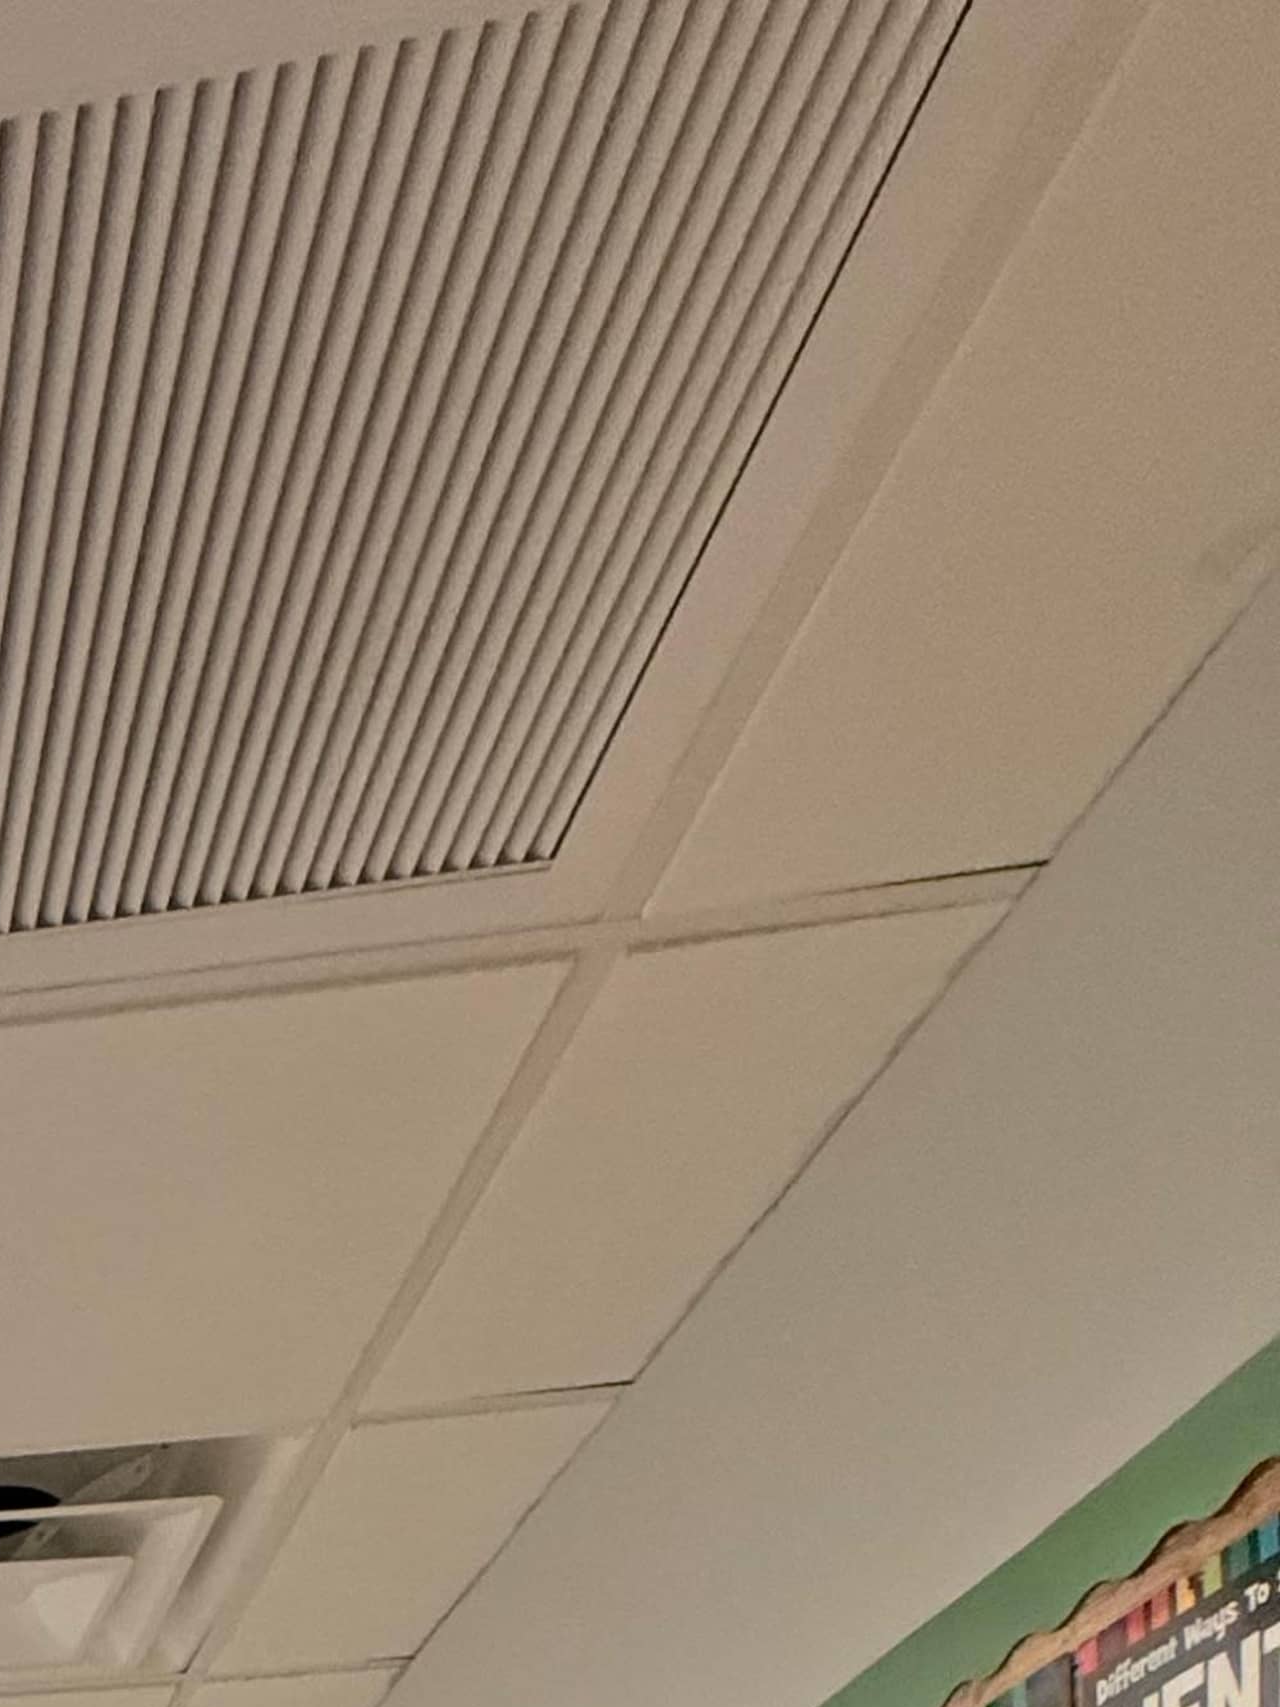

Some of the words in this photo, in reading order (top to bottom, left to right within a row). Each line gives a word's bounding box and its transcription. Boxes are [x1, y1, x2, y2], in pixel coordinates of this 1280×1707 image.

[1095, 1636, 1178, 1707] Different
[1184, 1600, 1239, 1651] Ways
[1243, 1582, 1271, 1612] To
